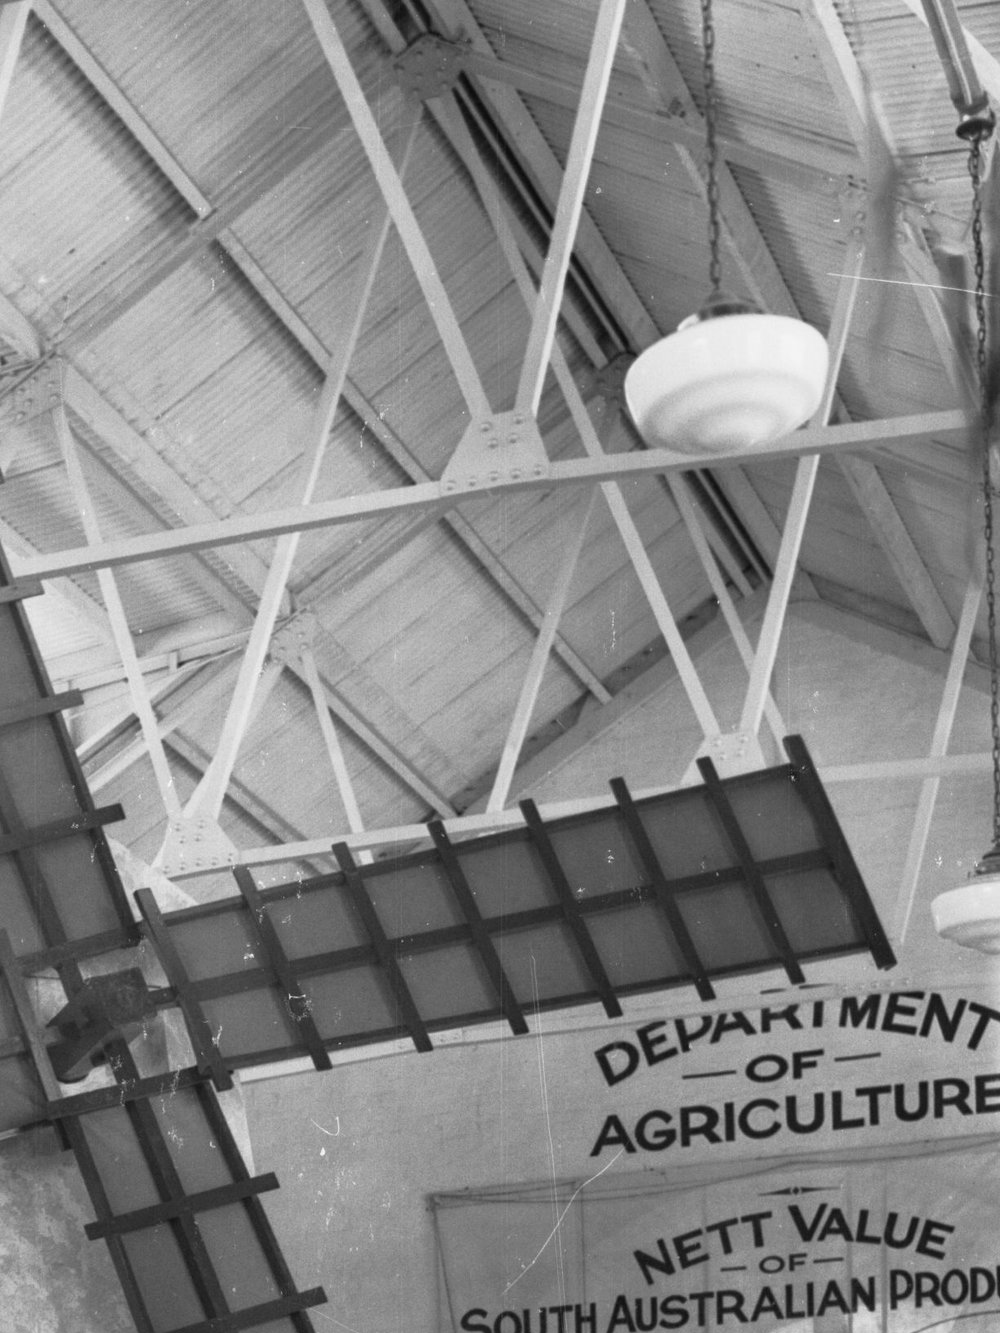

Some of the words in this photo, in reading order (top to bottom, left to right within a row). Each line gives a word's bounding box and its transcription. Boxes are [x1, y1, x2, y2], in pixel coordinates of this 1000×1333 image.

[594, 984, 1000, 1087] DEPARTMENT
[745, 1049, 825, 1083] OF
[590, 1073, 1000, 1157] AGRICULTURE
[634, 1211, 773, 1285] NETT
[788, 1203, 956, 1260] VALUE
[759, 1253, 807, 1274] OF
